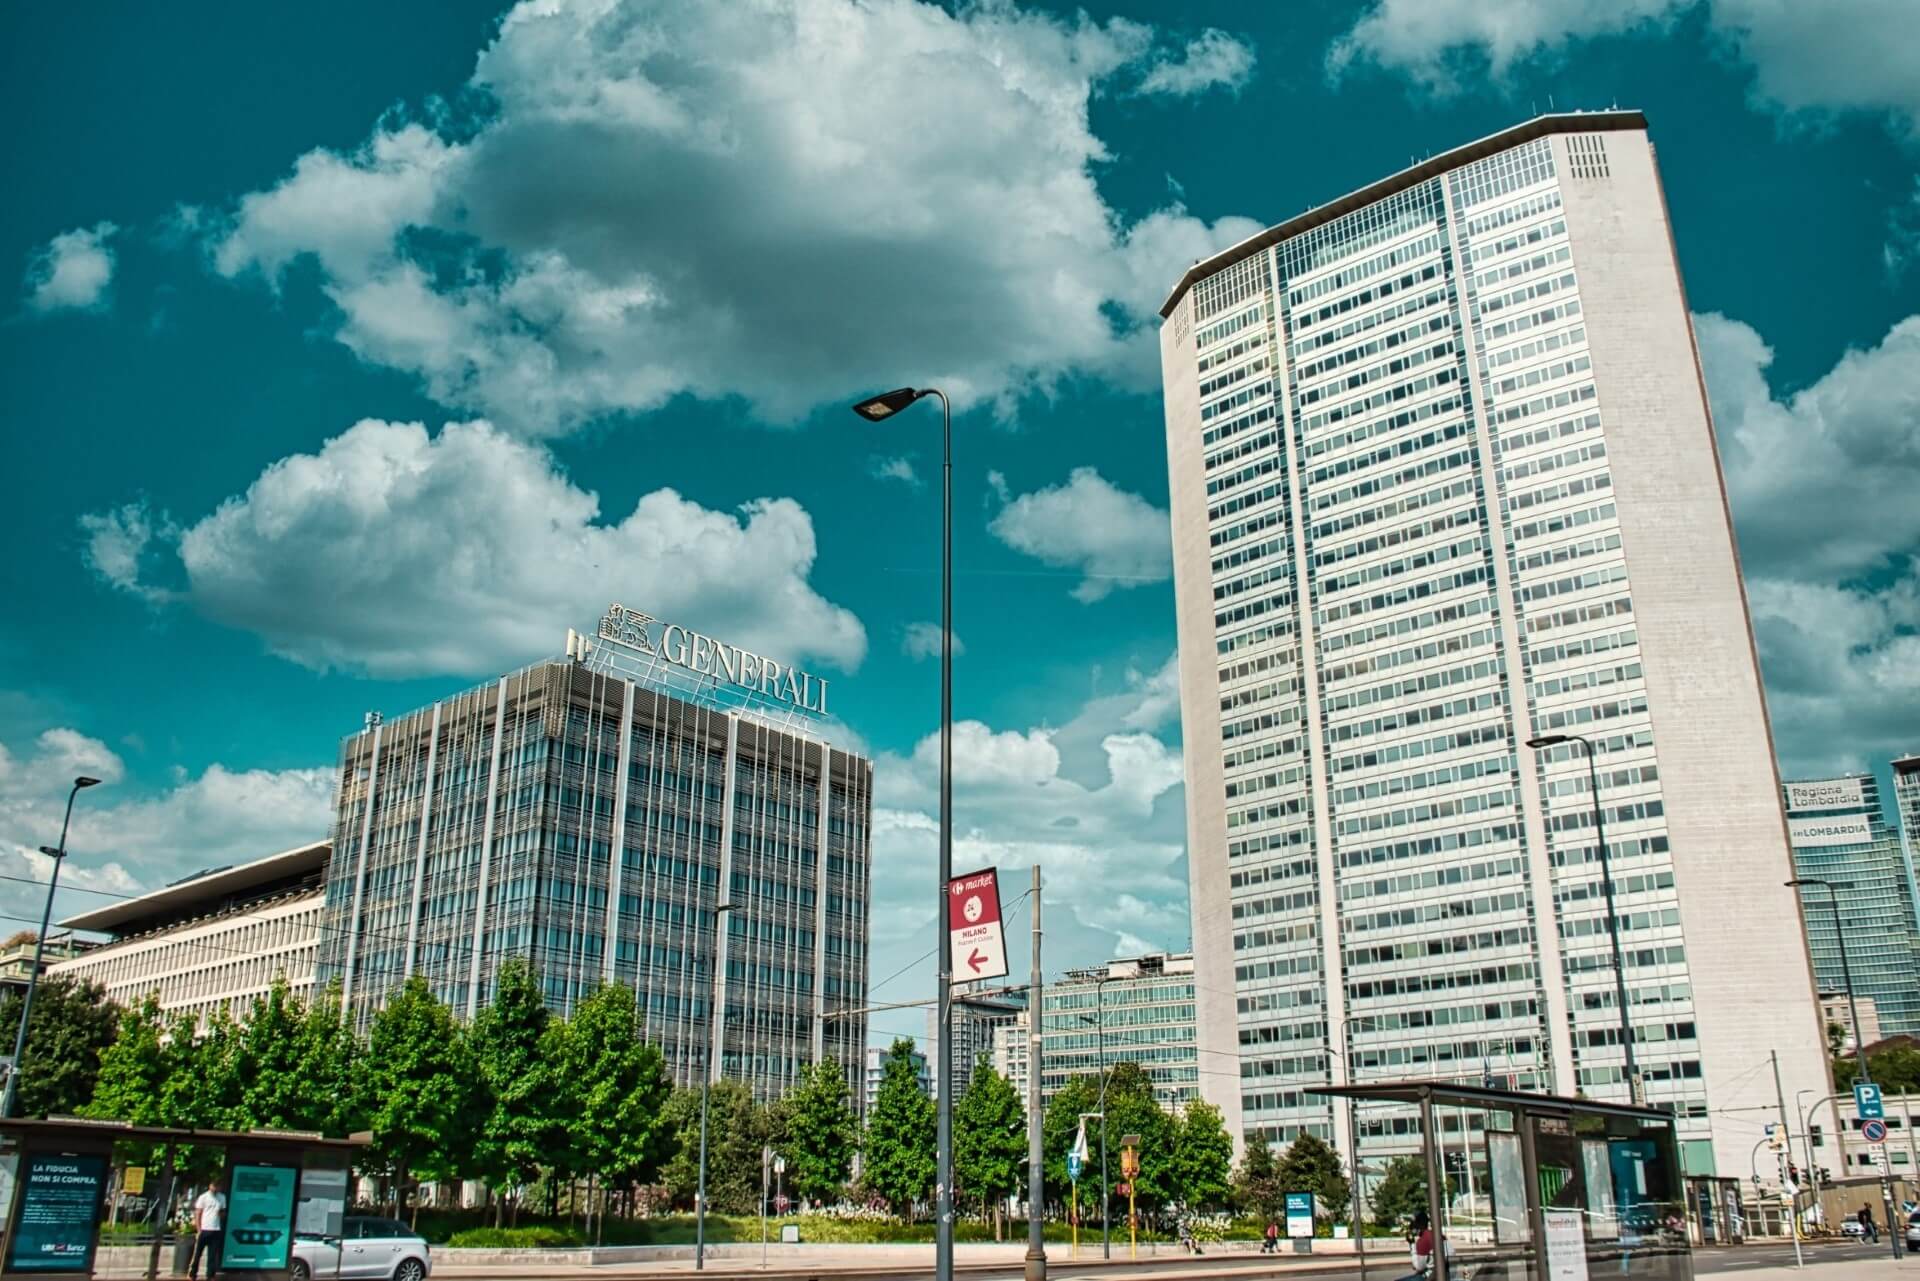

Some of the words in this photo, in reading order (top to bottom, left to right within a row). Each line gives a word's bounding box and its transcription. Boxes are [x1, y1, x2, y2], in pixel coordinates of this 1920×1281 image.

[662, 625, 829, 715] GENERALI
[1792, 786, 1842, 797] Regione
[1794, 794, 1860, 807] Lombardia
[966, 873, 993, 890] market
[962, 927, 988, 938] MILANO
[1859, 1087, 1875, 1104] P
[33, 1164, 44, 1172] LA
[45, 1164, 78, 1174] FIDUCIA
[31, 1175, 51, 1183] NON
[52, 1175, 61, 1183] SI
